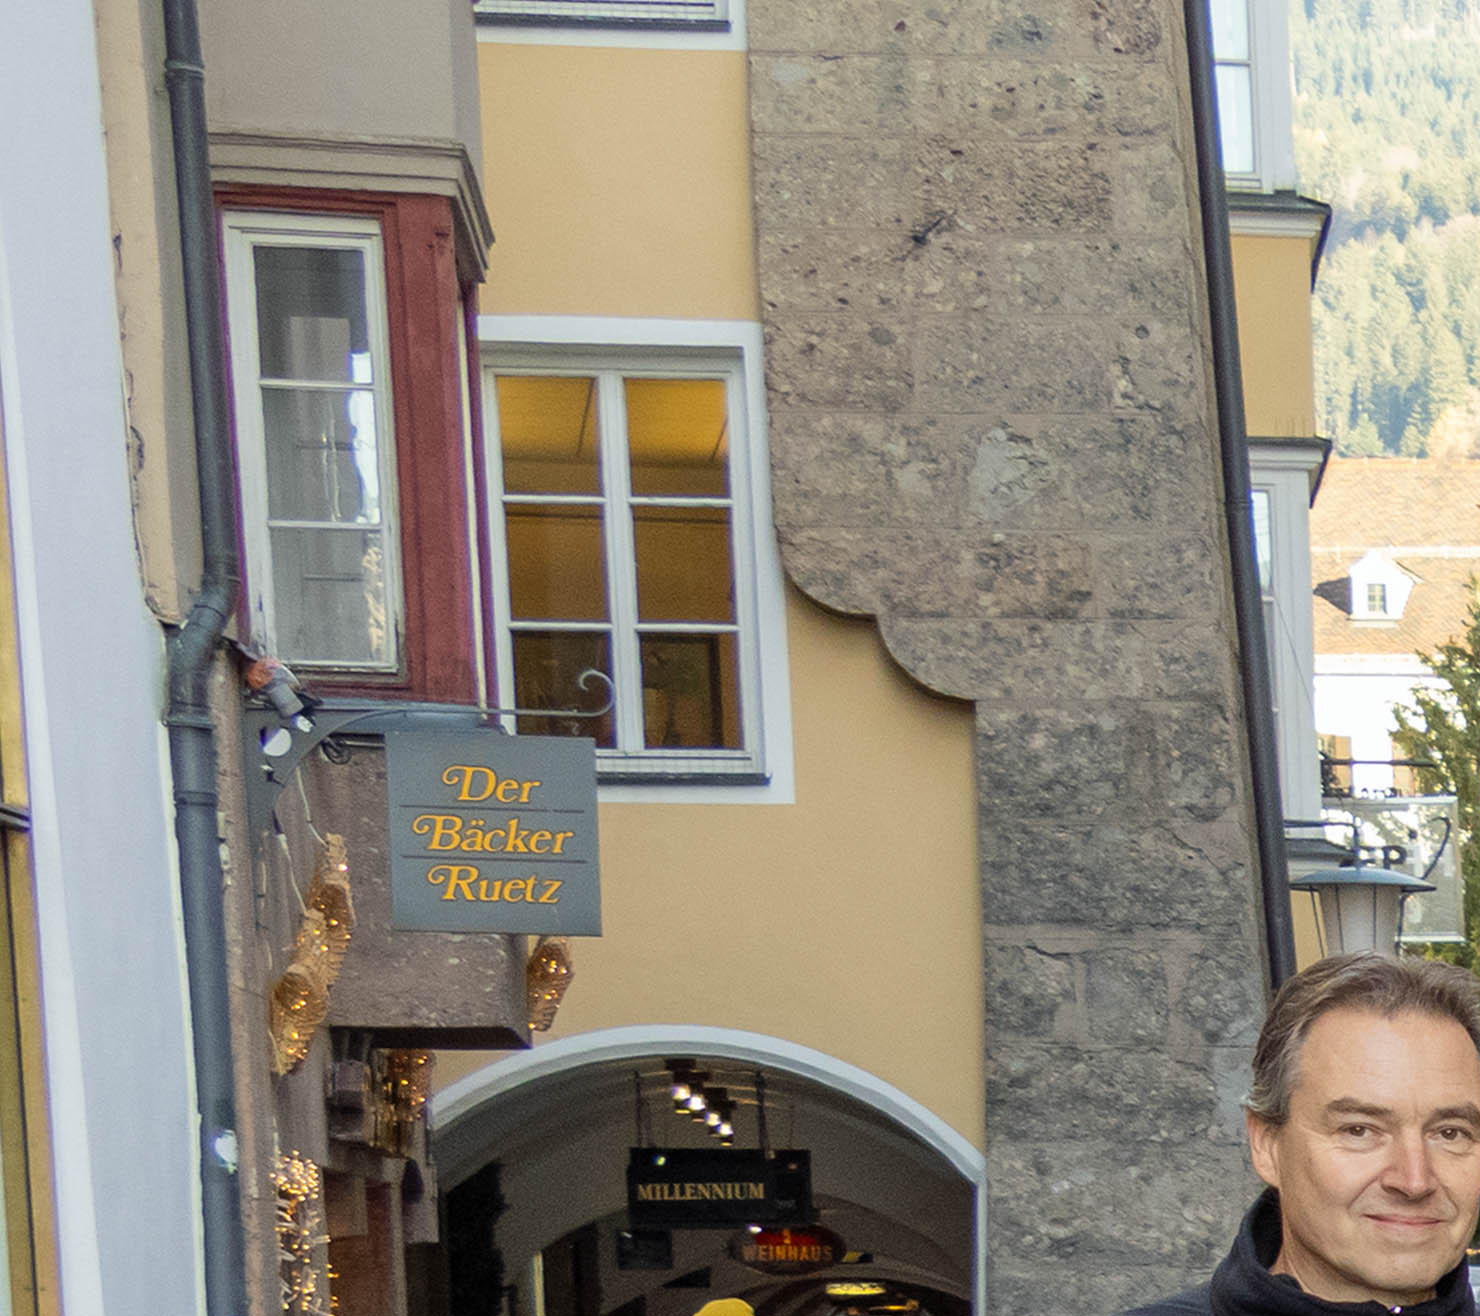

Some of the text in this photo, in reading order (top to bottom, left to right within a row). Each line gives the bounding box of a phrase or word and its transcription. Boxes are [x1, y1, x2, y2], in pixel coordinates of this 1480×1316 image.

[441, 764, 542, 803] Der
[411, 814, 575, 854] Bäcker
[426, 864, 563, 904] Ruetz
[637, 1182, 765, 1201] MILLENNIUM
[742, 1245, 833, 1262] WEINHAUS
